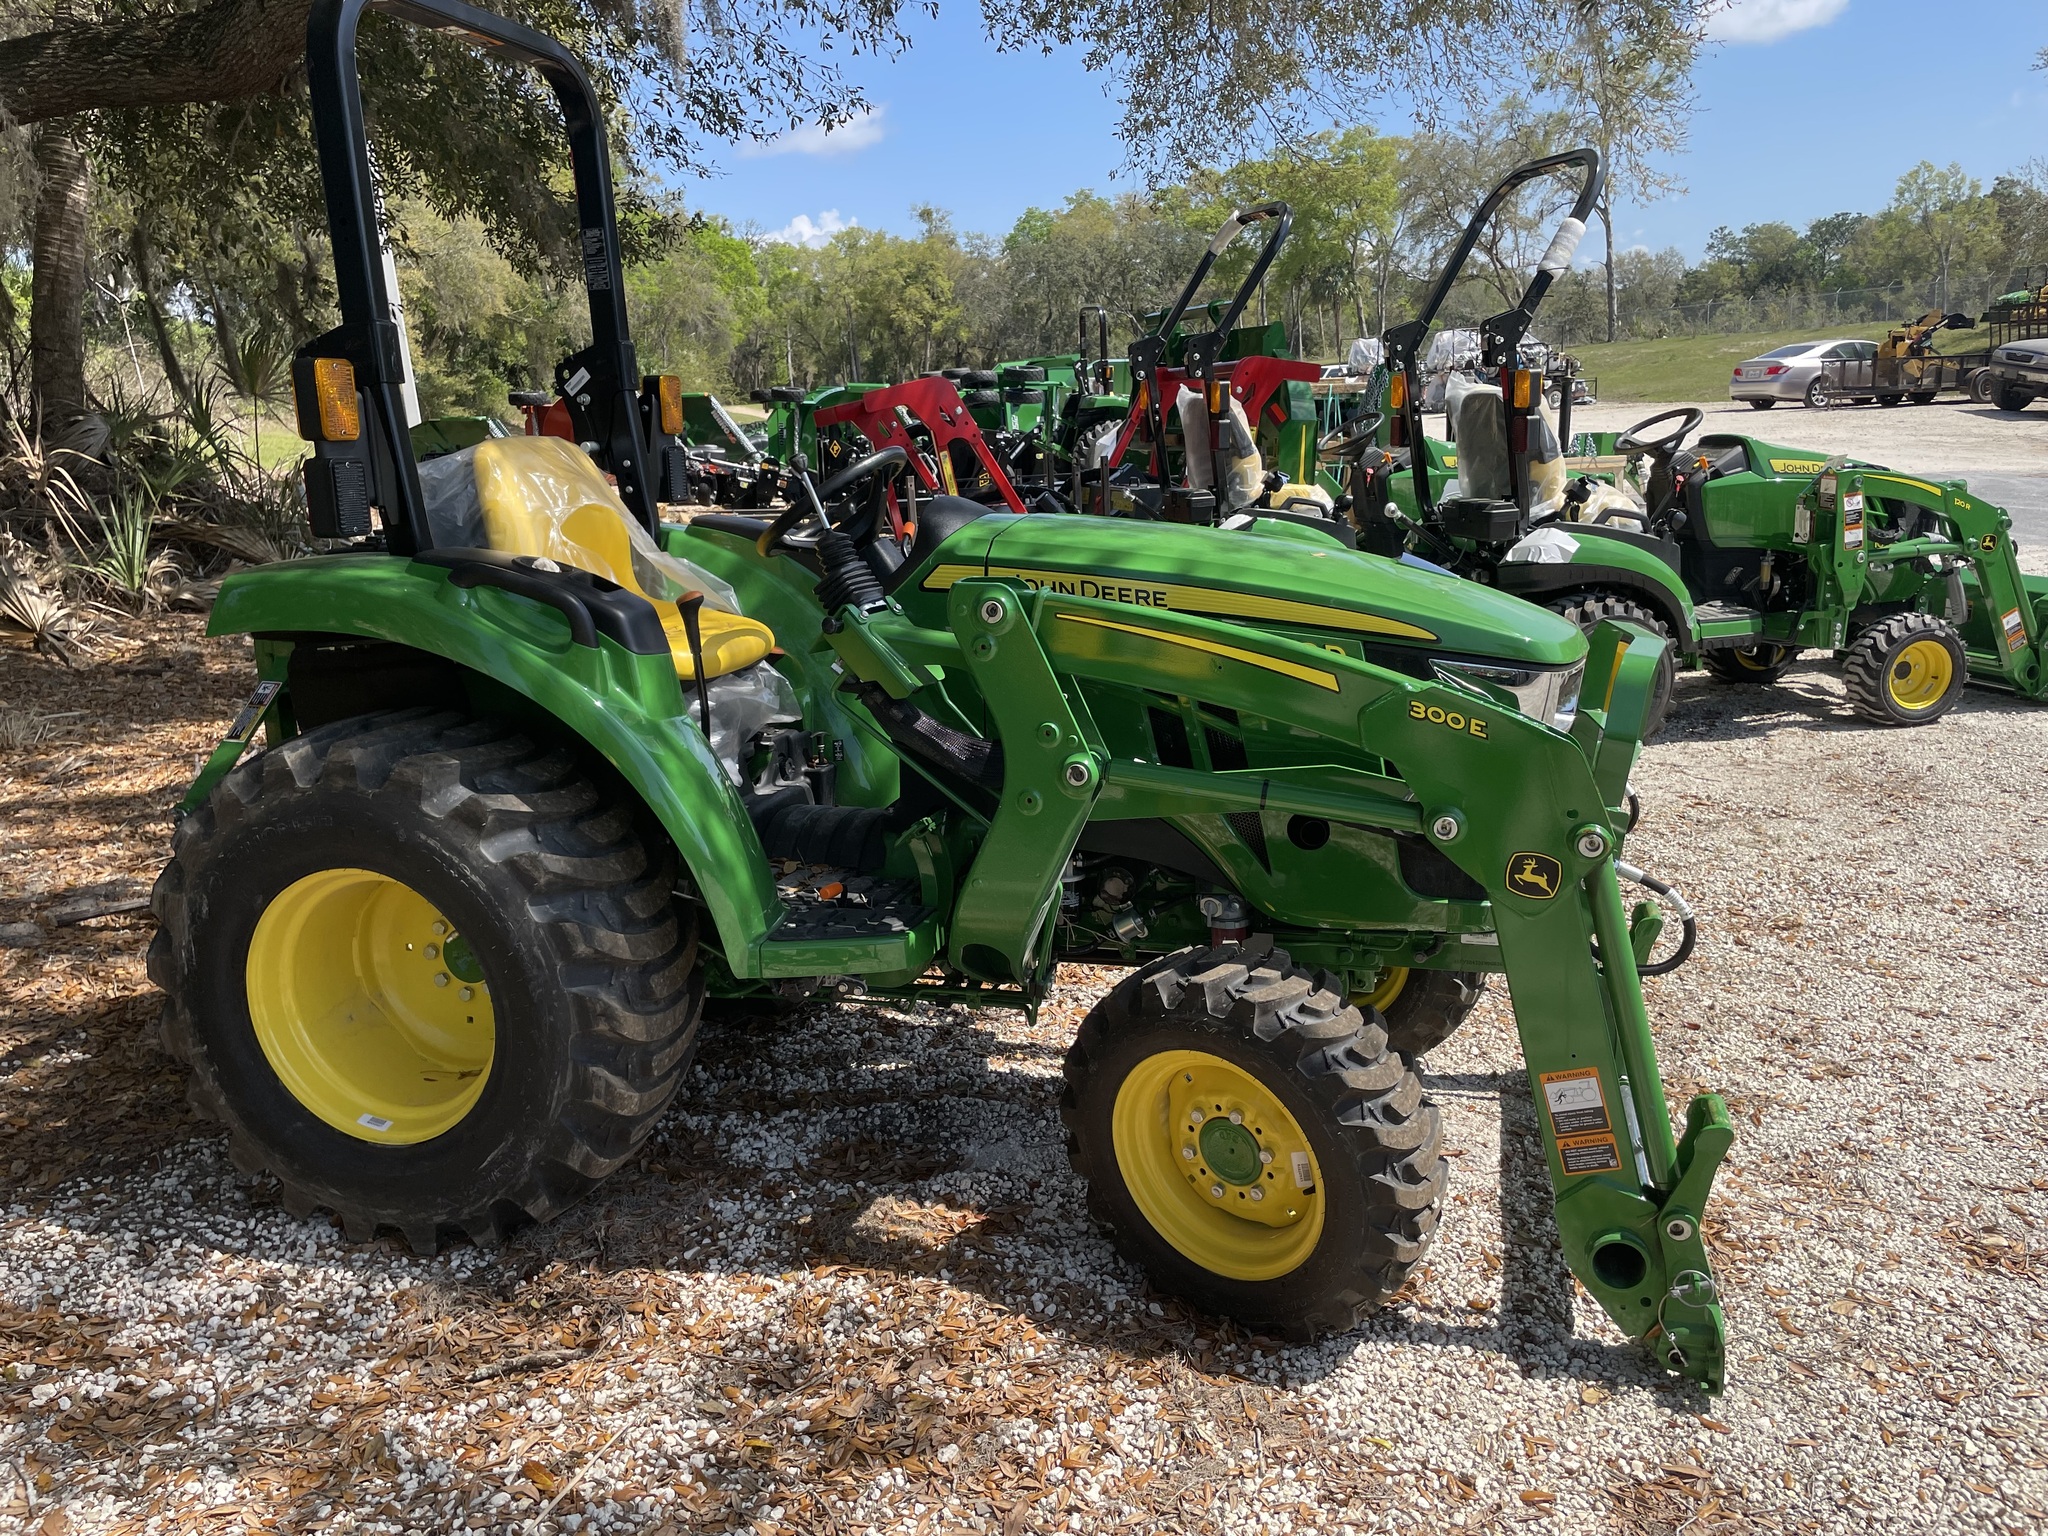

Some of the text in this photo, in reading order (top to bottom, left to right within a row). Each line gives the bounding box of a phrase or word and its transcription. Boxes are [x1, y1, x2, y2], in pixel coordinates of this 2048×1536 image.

[1780, 463, 1810, 472] JOHN
[1080, 580, 1168, 608] DEERE
[1555, 1070, 1591, 1081] WARNING
[1573, 1136, 1609, 1147] WARNING
